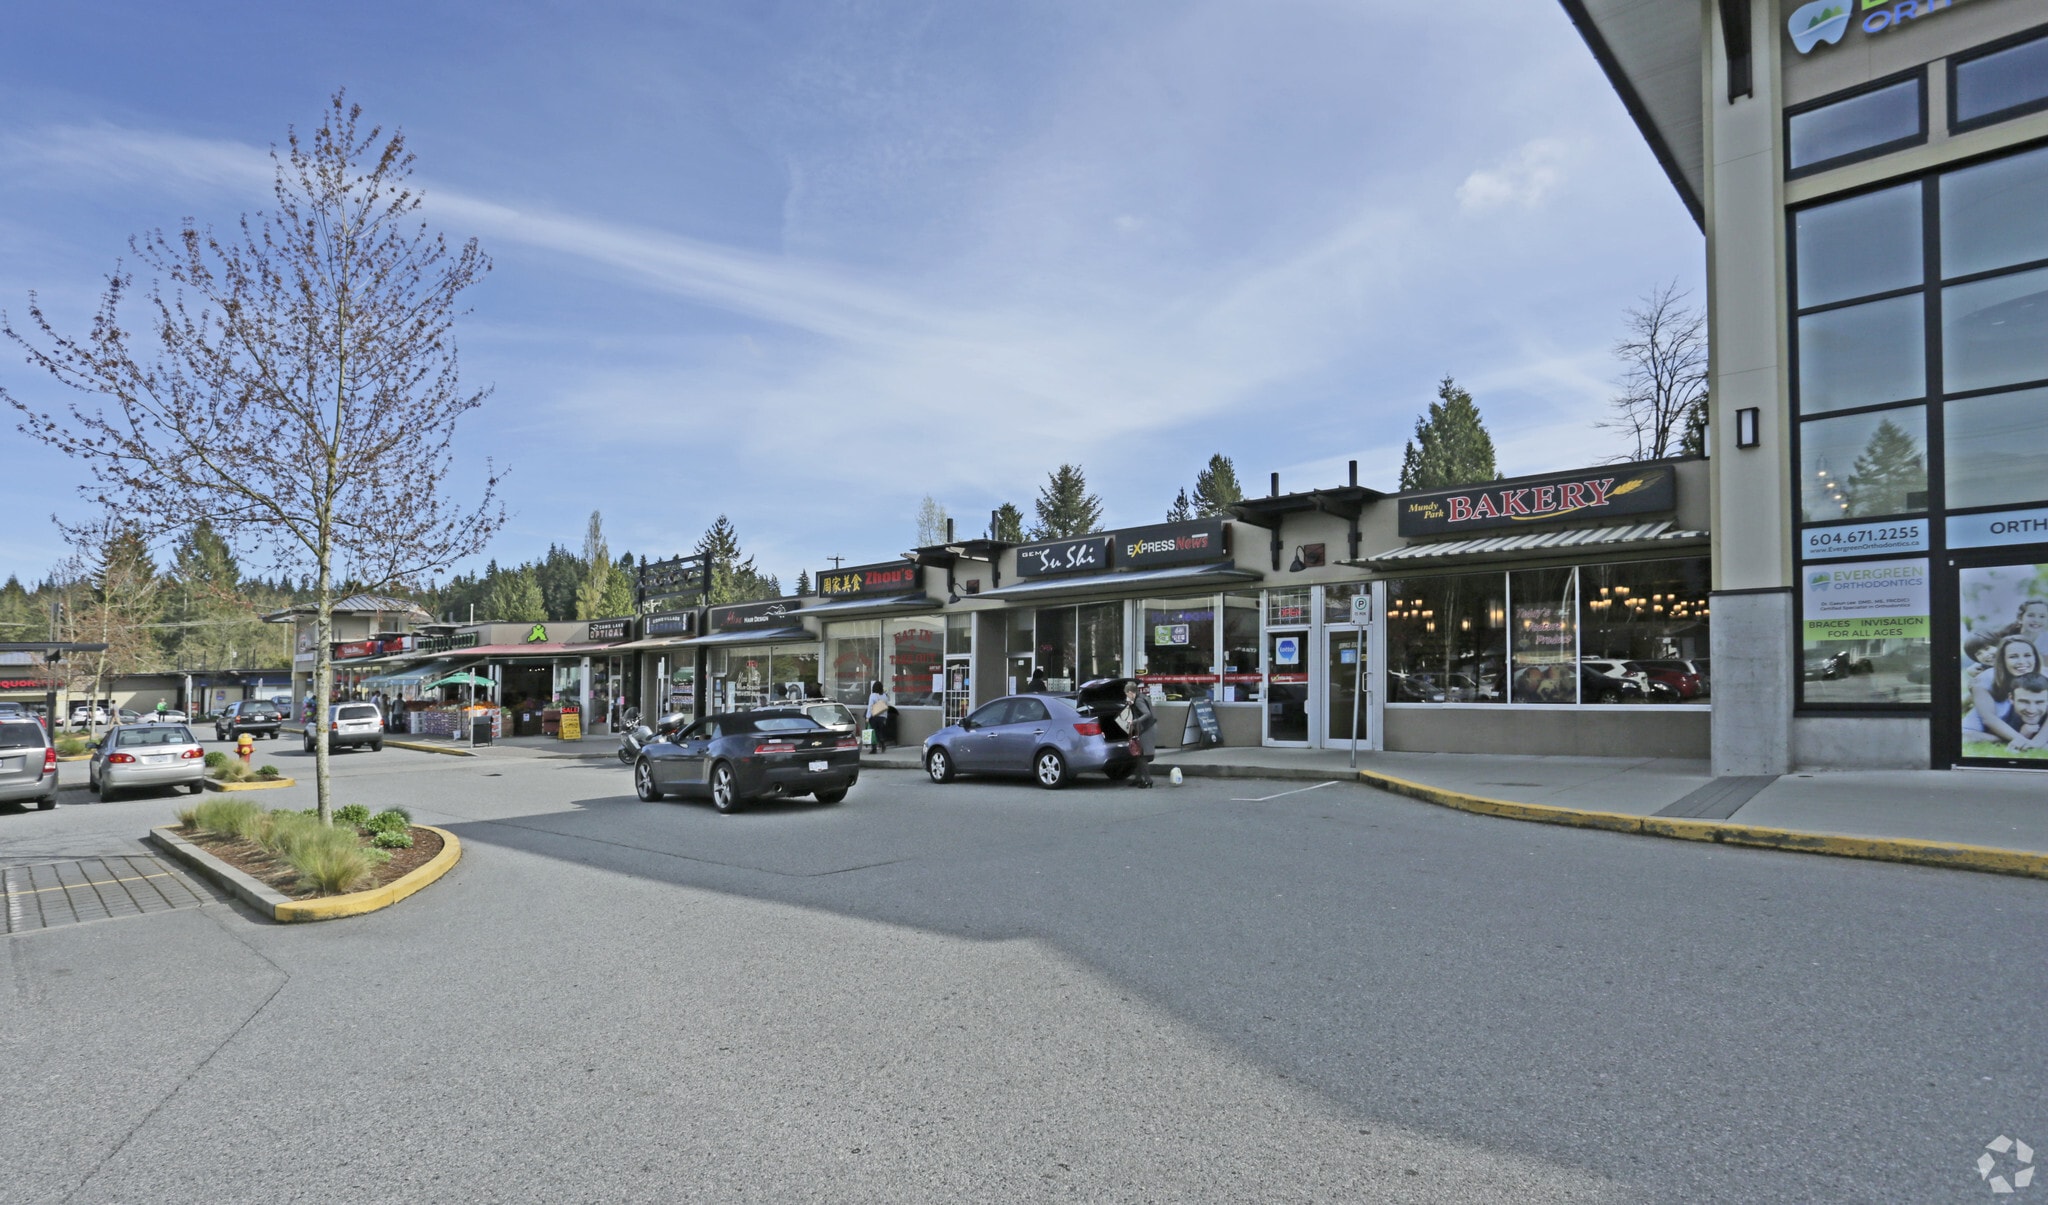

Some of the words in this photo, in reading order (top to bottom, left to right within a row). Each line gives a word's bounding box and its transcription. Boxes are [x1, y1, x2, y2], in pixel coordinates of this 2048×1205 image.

[1447, 478, 1614, 522] BAKERY
[1408, 501, 1438, 512] Mundy
[1424, 509, 1444, 519] Park
[1990, 518, 2048, 534] ORTH
[1810, 526, 1919, 546] 604.671.2255
[1810, 541, 1920, 553] www.EvergreenOrthodontics.ca
[1066, 544, 1095, 568] Shi
[865, 568, 914, 585] Zhou's
[1834, 566, 1924, 581] EVERGREEN
[1834, 578, 1923, 590] ORTHODONTICS
[1279, 607, 1302, 617] OPEN
[1808, 620, 1851, 629] BRACES
[1861, 617, 1924, 627] INVISALIGN
[590, 629, 624, 638] OPTICAL
[893, 628, 916, 644] EAT
[919, 629, 933, 643] IN
[1828, 630, 1849, 638] FOR
[1852, 629, 1871, 637] ALL
[1874, 628, 1903, 636] AGES
